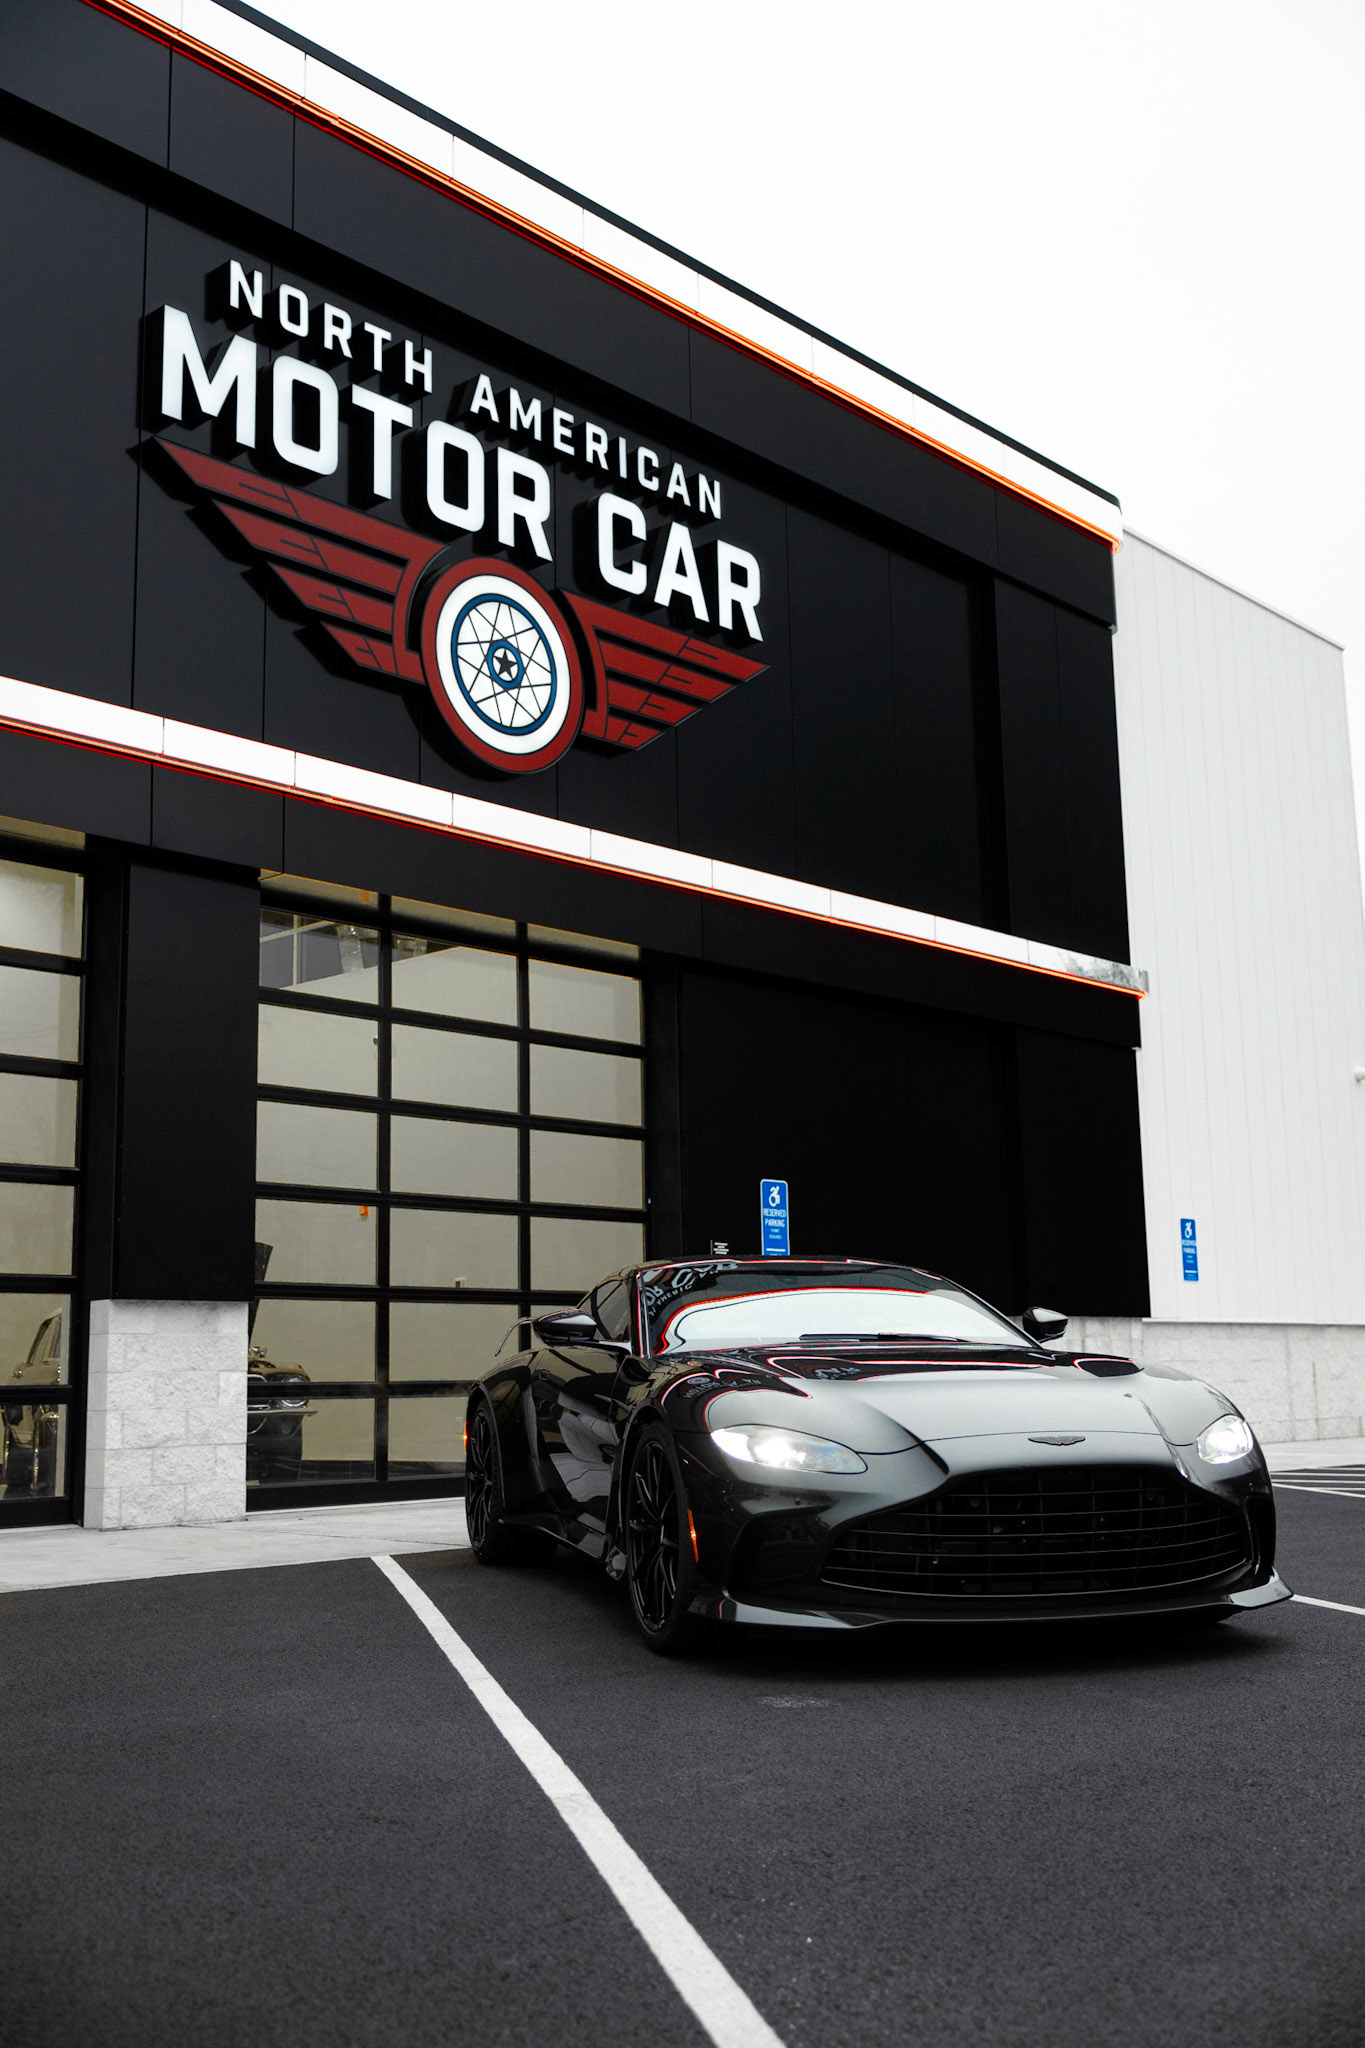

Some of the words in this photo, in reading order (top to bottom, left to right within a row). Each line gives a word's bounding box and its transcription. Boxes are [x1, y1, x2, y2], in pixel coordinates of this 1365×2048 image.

[229, 259, 433, 394] NORTH
[470, 373, 722, 520] AMERICAN
[161, 304, 553, 562] MOTOR
[597, 492, 764, 642] CAR
[763, 1208, 787, 1218] RESERVED
[765, 1218, 785, 1228] PARKING
